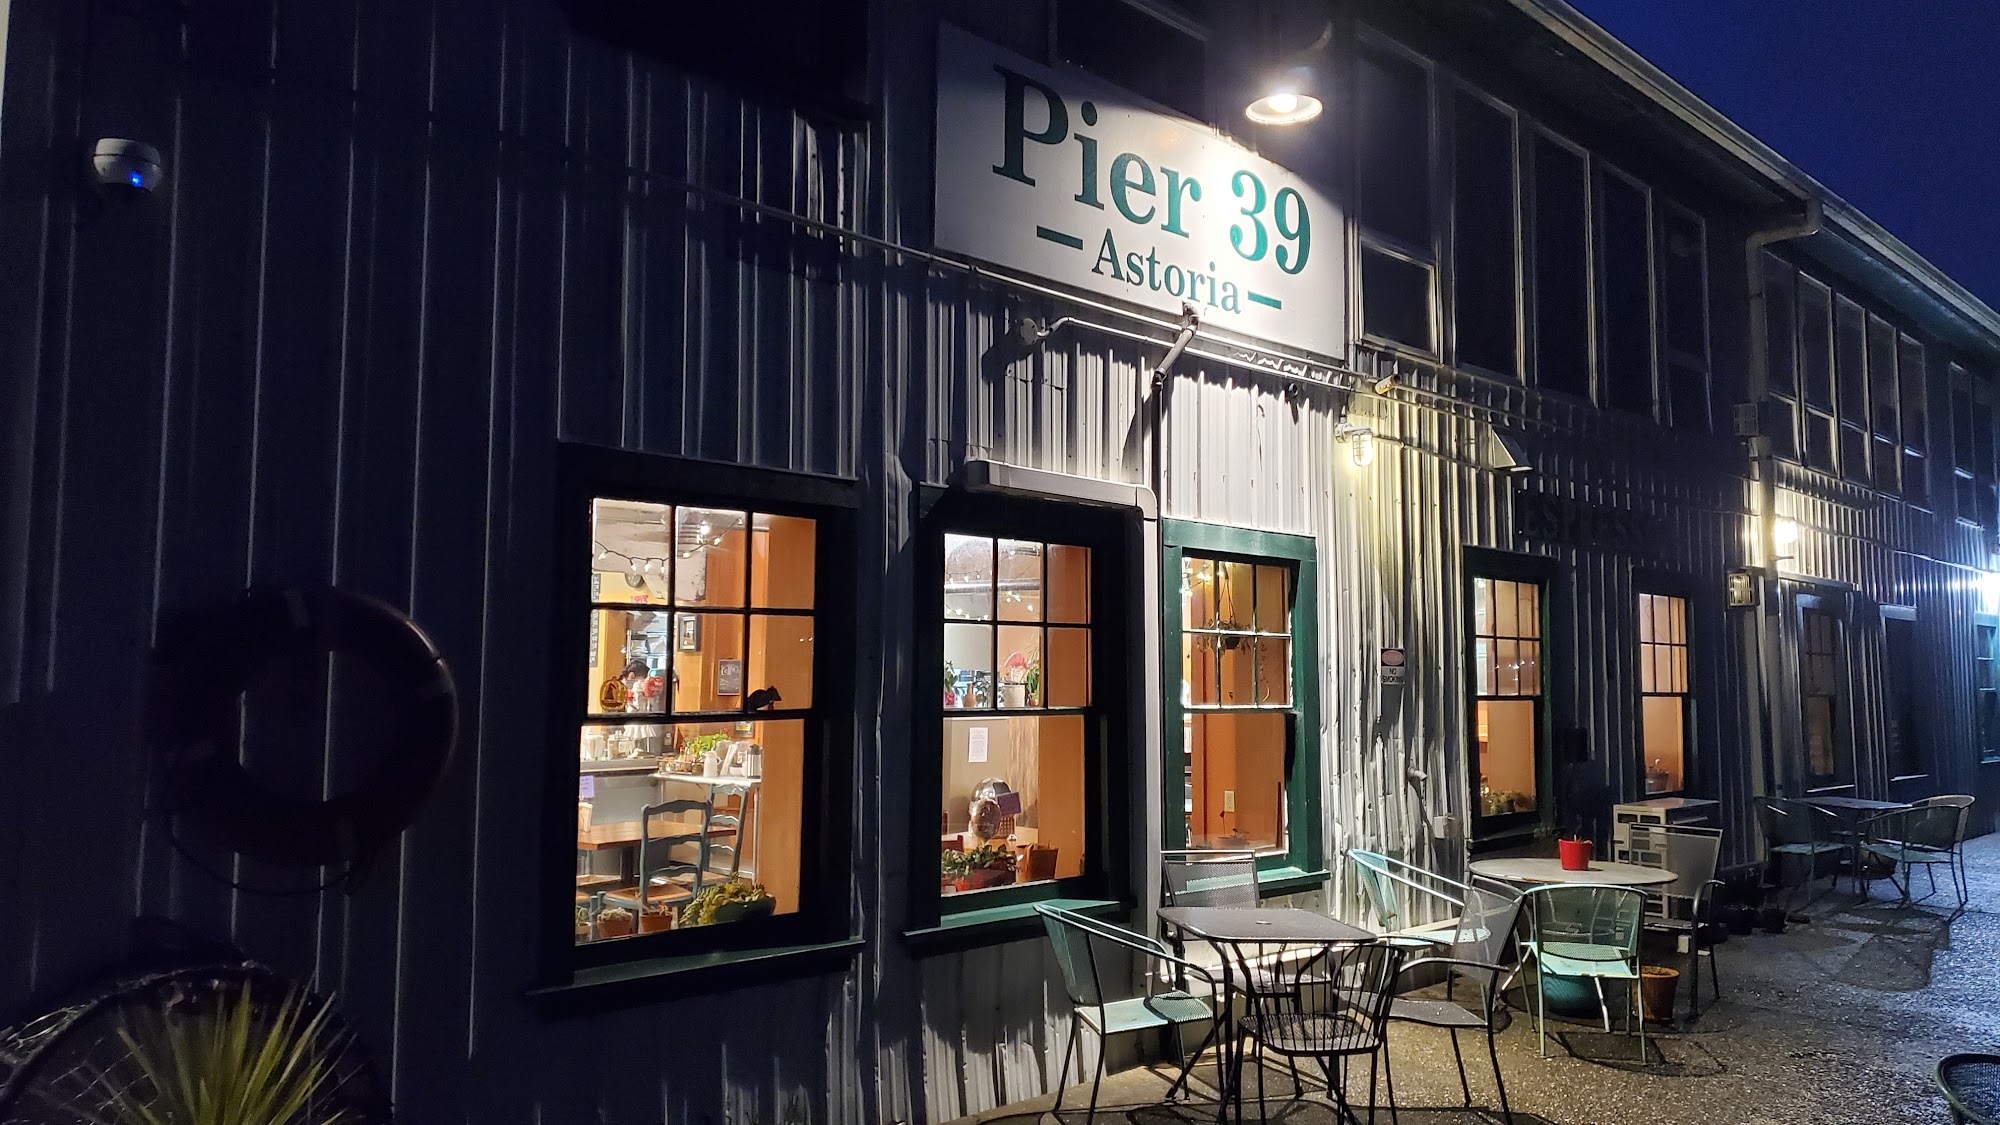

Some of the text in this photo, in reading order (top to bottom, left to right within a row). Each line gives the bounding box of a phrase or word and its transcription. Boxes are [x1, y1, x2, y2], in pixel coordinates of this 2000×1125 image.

[992, 64, 1312, 275] Pier 39
[1091, 228, 1242, 315] Astoria
[1524, 494, 1652, 551] ESPRESS
